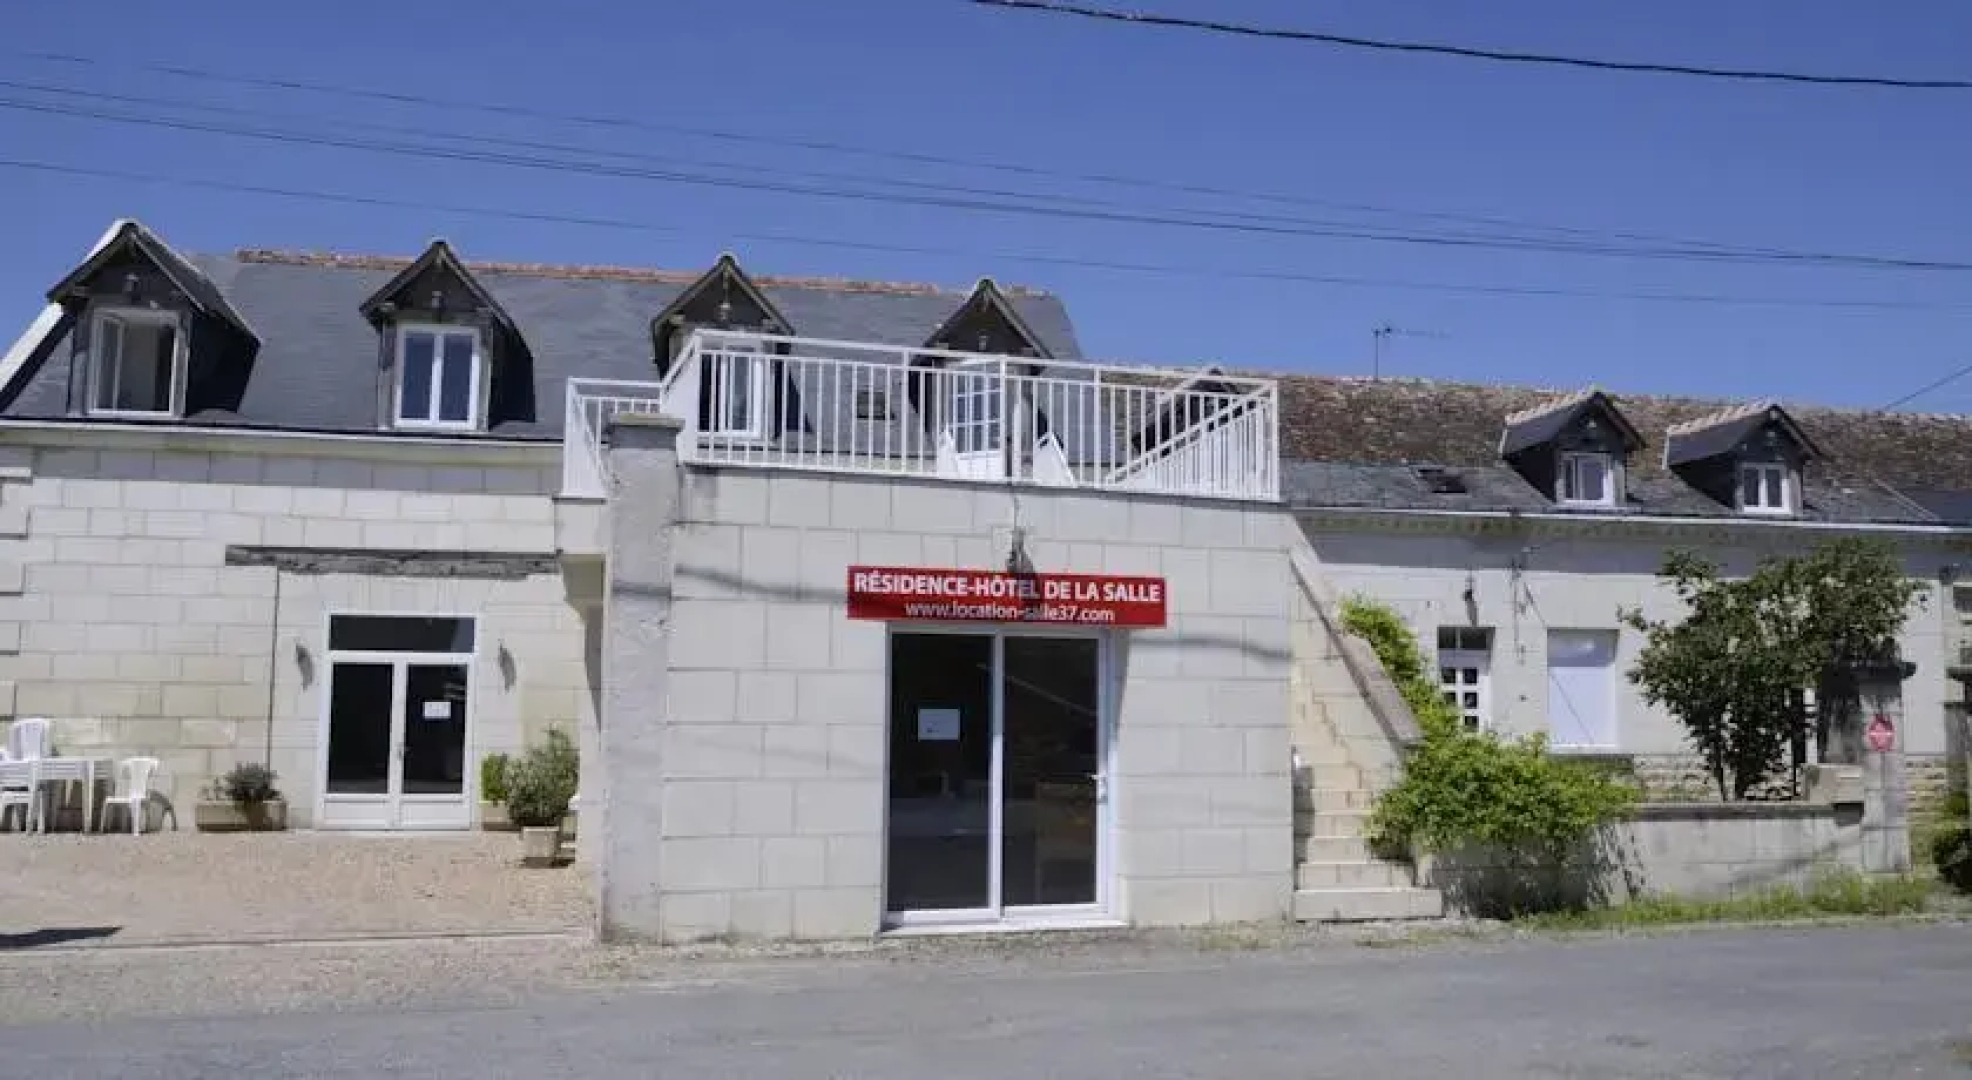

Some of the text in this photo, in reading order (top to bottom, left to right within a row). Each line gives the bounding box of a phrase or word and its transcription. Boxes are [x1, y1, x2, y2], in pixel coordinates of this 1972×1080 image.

[854, 570, 1161, 602] RÉSIDENCE-HÔTEL DE LA SALLE
[905, 600, 1115, 623] www.location-salle37.com
